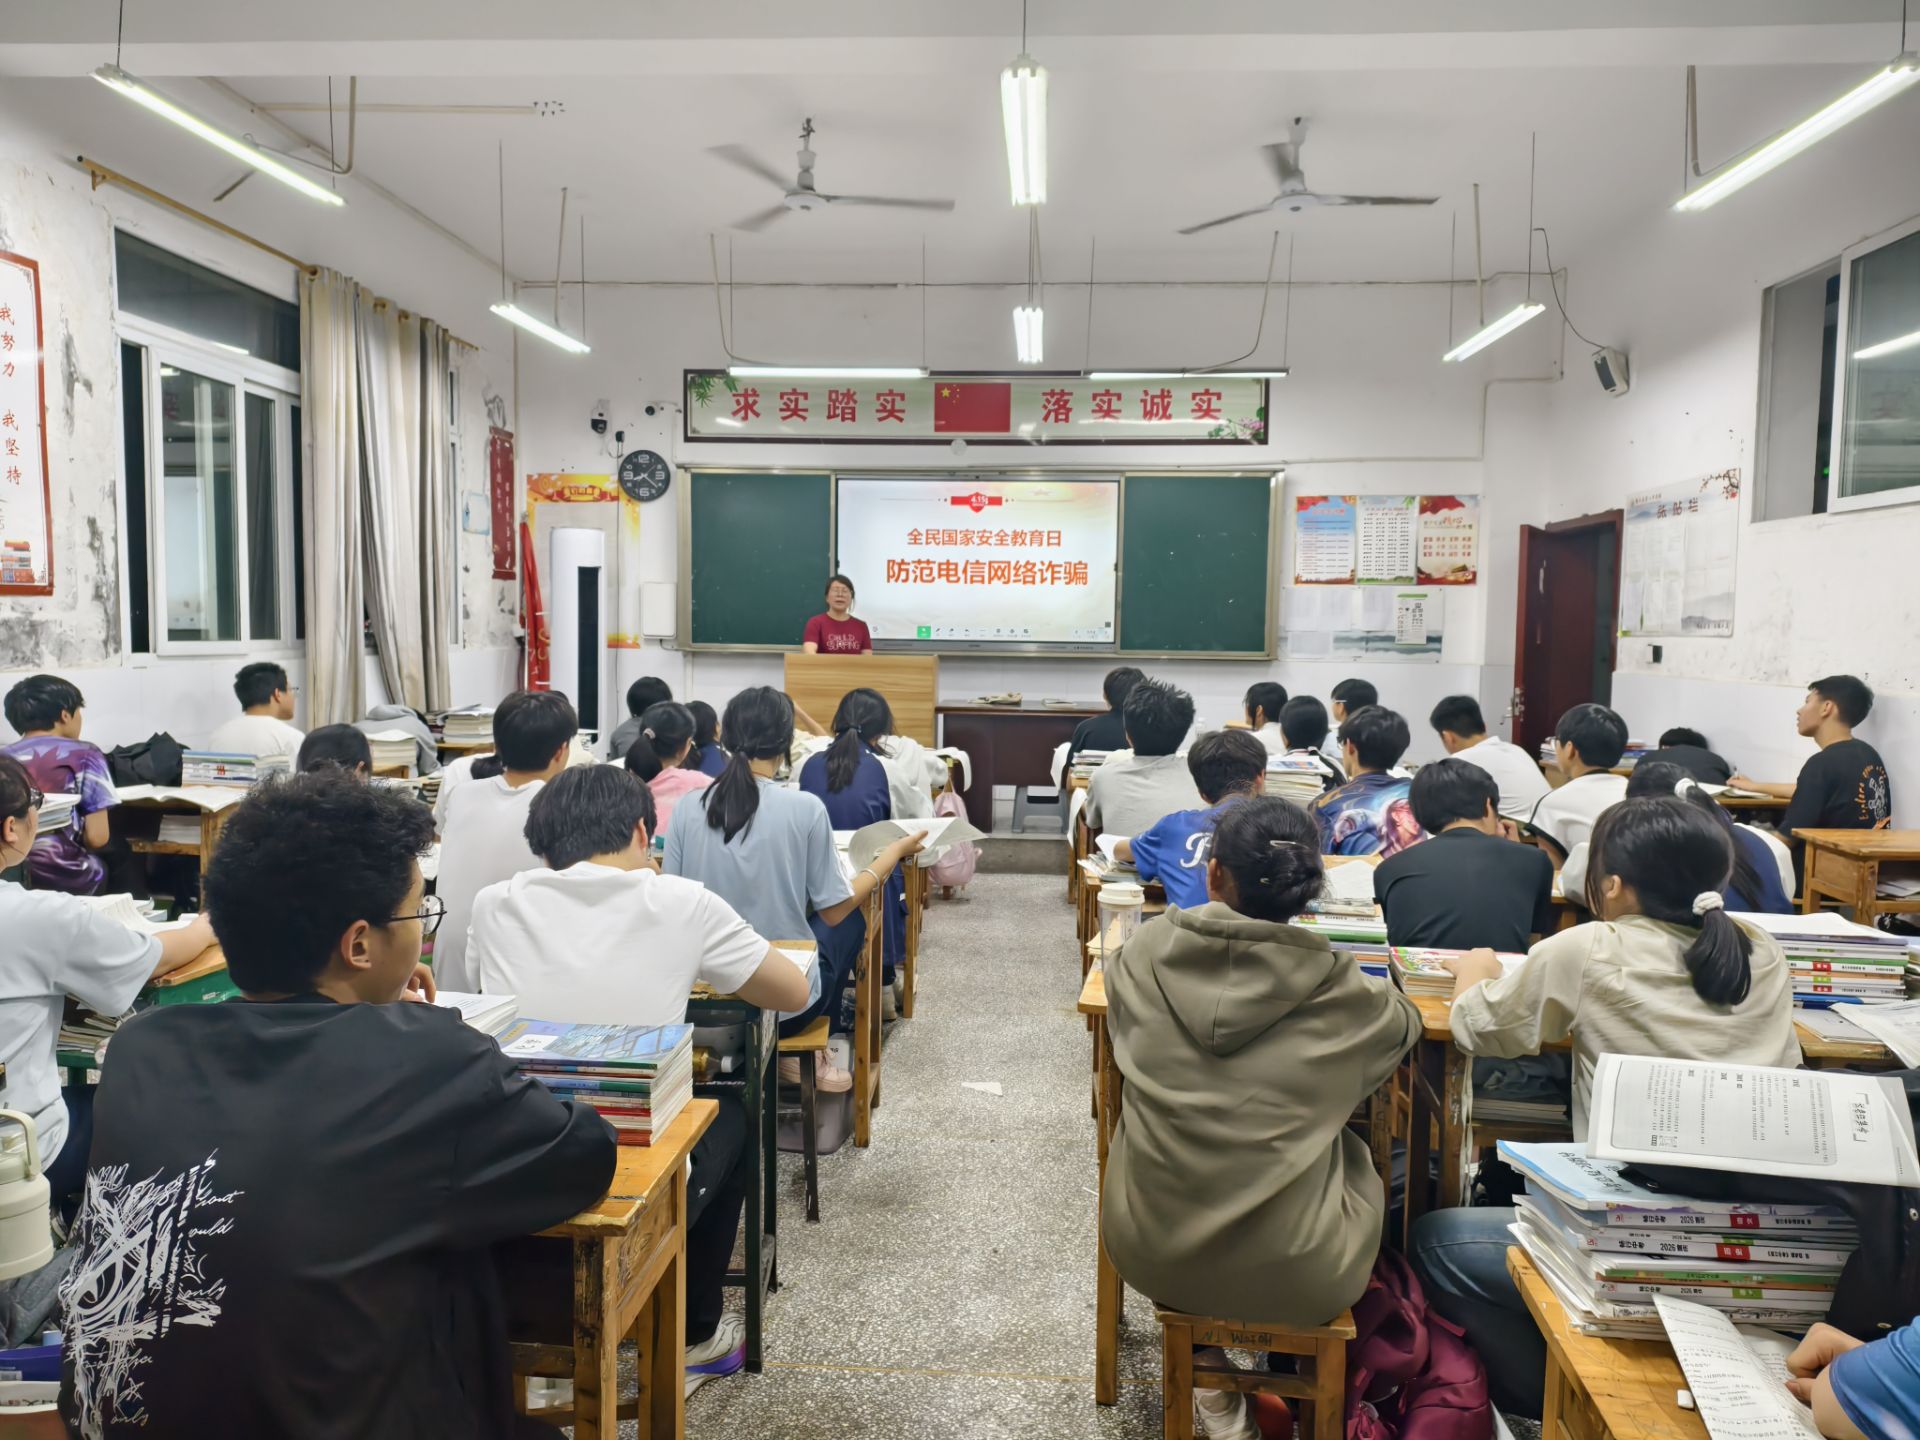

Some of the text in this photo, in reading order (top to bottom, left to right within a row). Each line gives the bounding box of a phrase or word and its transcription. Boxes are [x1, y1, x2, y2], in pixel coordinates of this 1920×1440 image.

[0, 303, 22, 487] 我努力 我坚持
[731, 388, 1223, 423] 求实踏实 落实诚实
[638, 454, 650, 463] 12
[623, 471, 634, 480] 9
[655, 471, 666, 480] 3
[639, 487, 650, 497] 6
[907, 527, 1062, 547] 全民国家安全教育日
[886, 559, 1089, 586] 防范电信网络诈骗
